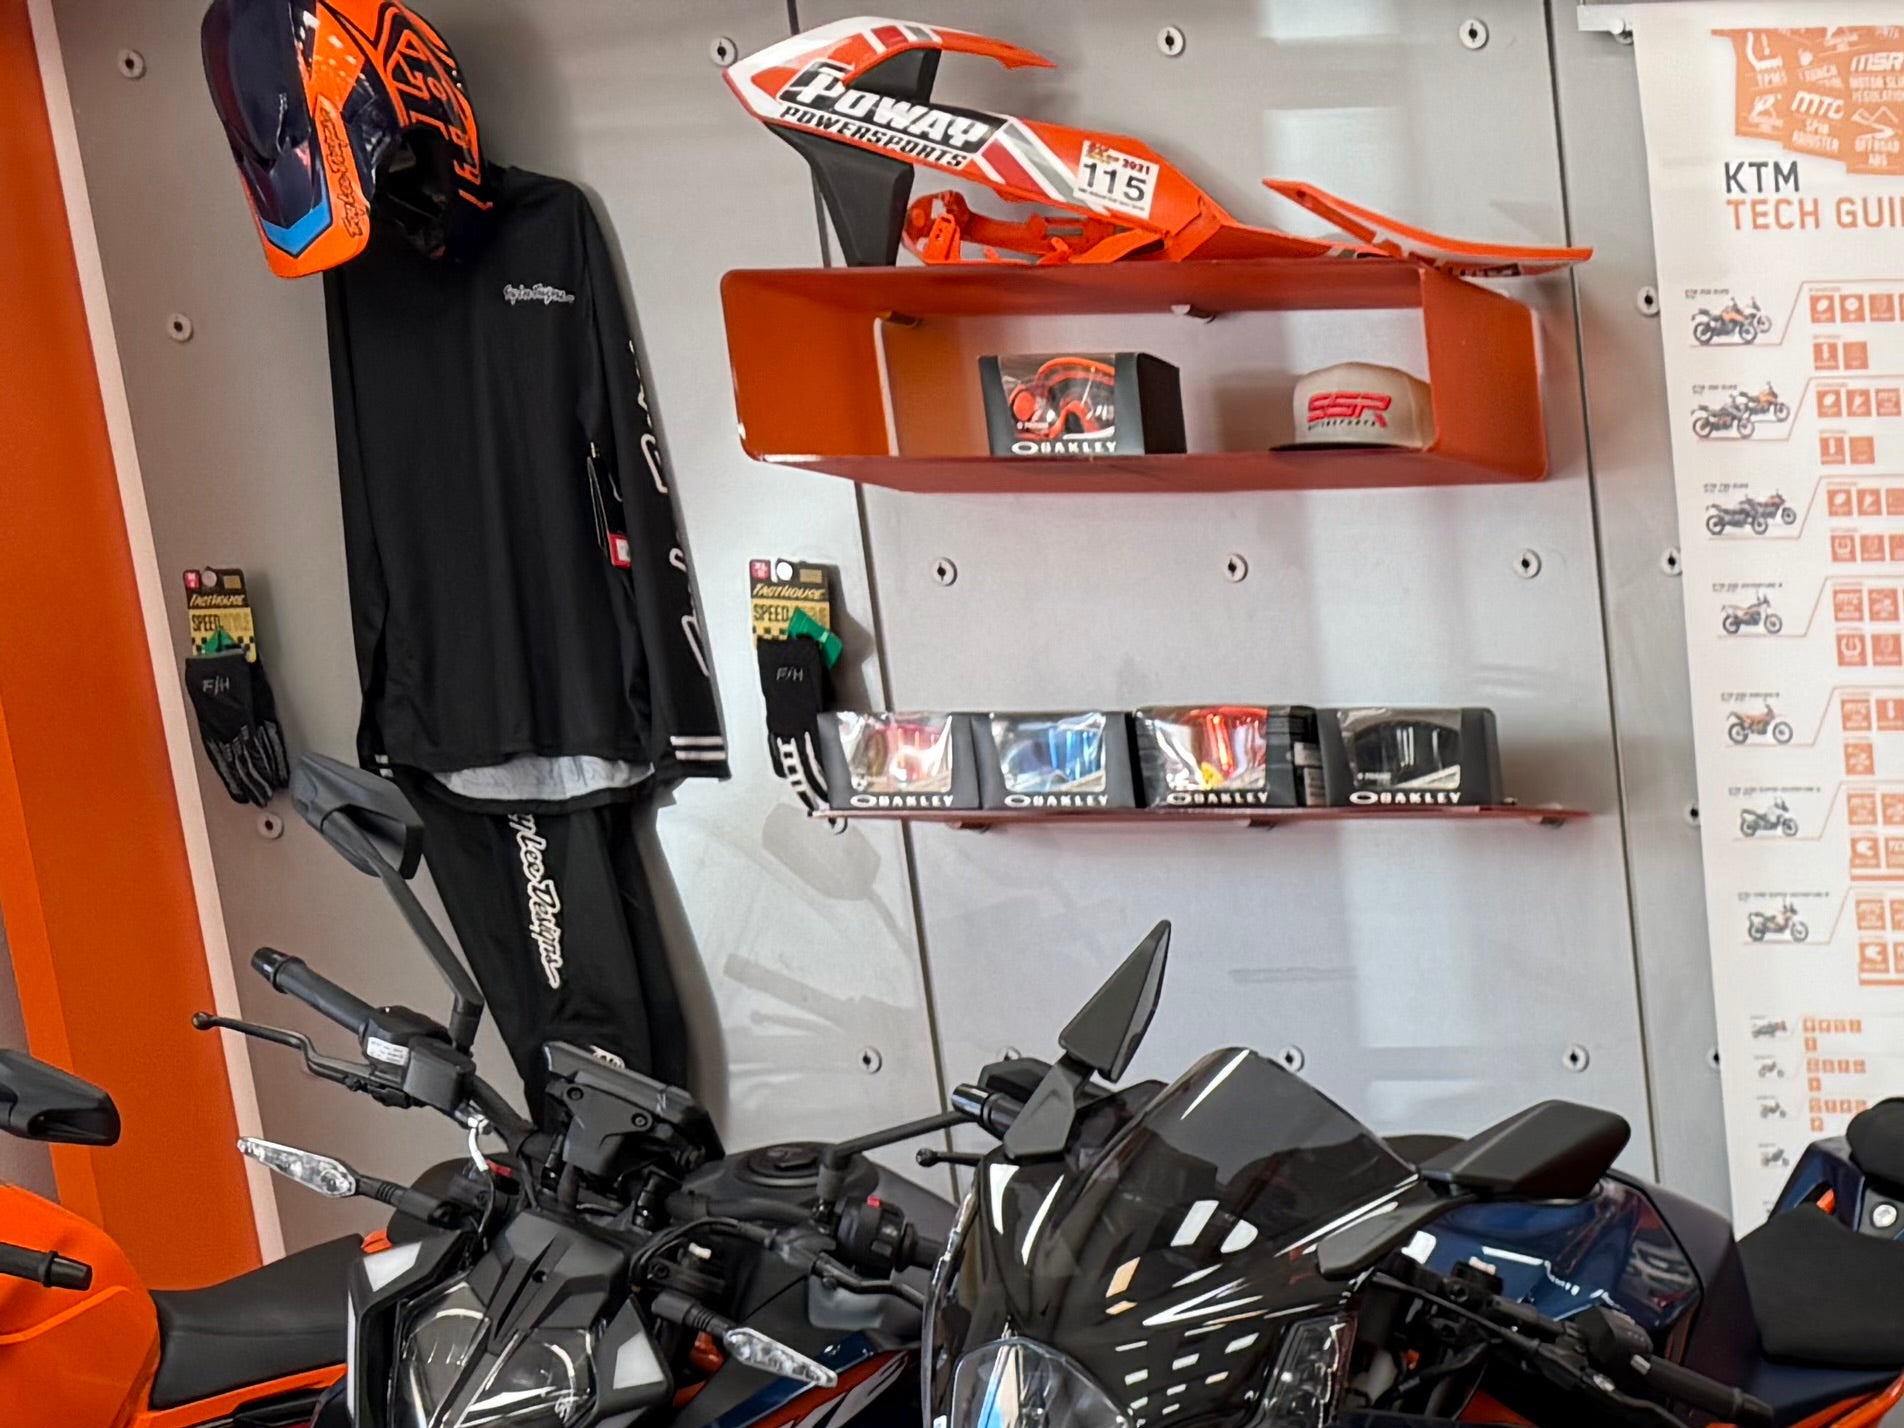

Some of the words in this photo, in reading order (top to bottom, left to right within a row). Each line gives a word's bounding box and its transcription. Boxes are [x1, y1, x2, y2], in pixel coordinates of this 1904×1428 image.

[1851, 51, 1904, 72] MSR
[796, 66, 989, 147] POWAY
[1791, 90, 1846, 120] MTC
[779, 105, 968, 168] POWERSPORTS
[1083, 161, 1145, 203] 115
[1724, 160, 1800, 193] KTM
[1727, 197, 1820, 230] TECH
[753, 603, 790, 622] SPEED
